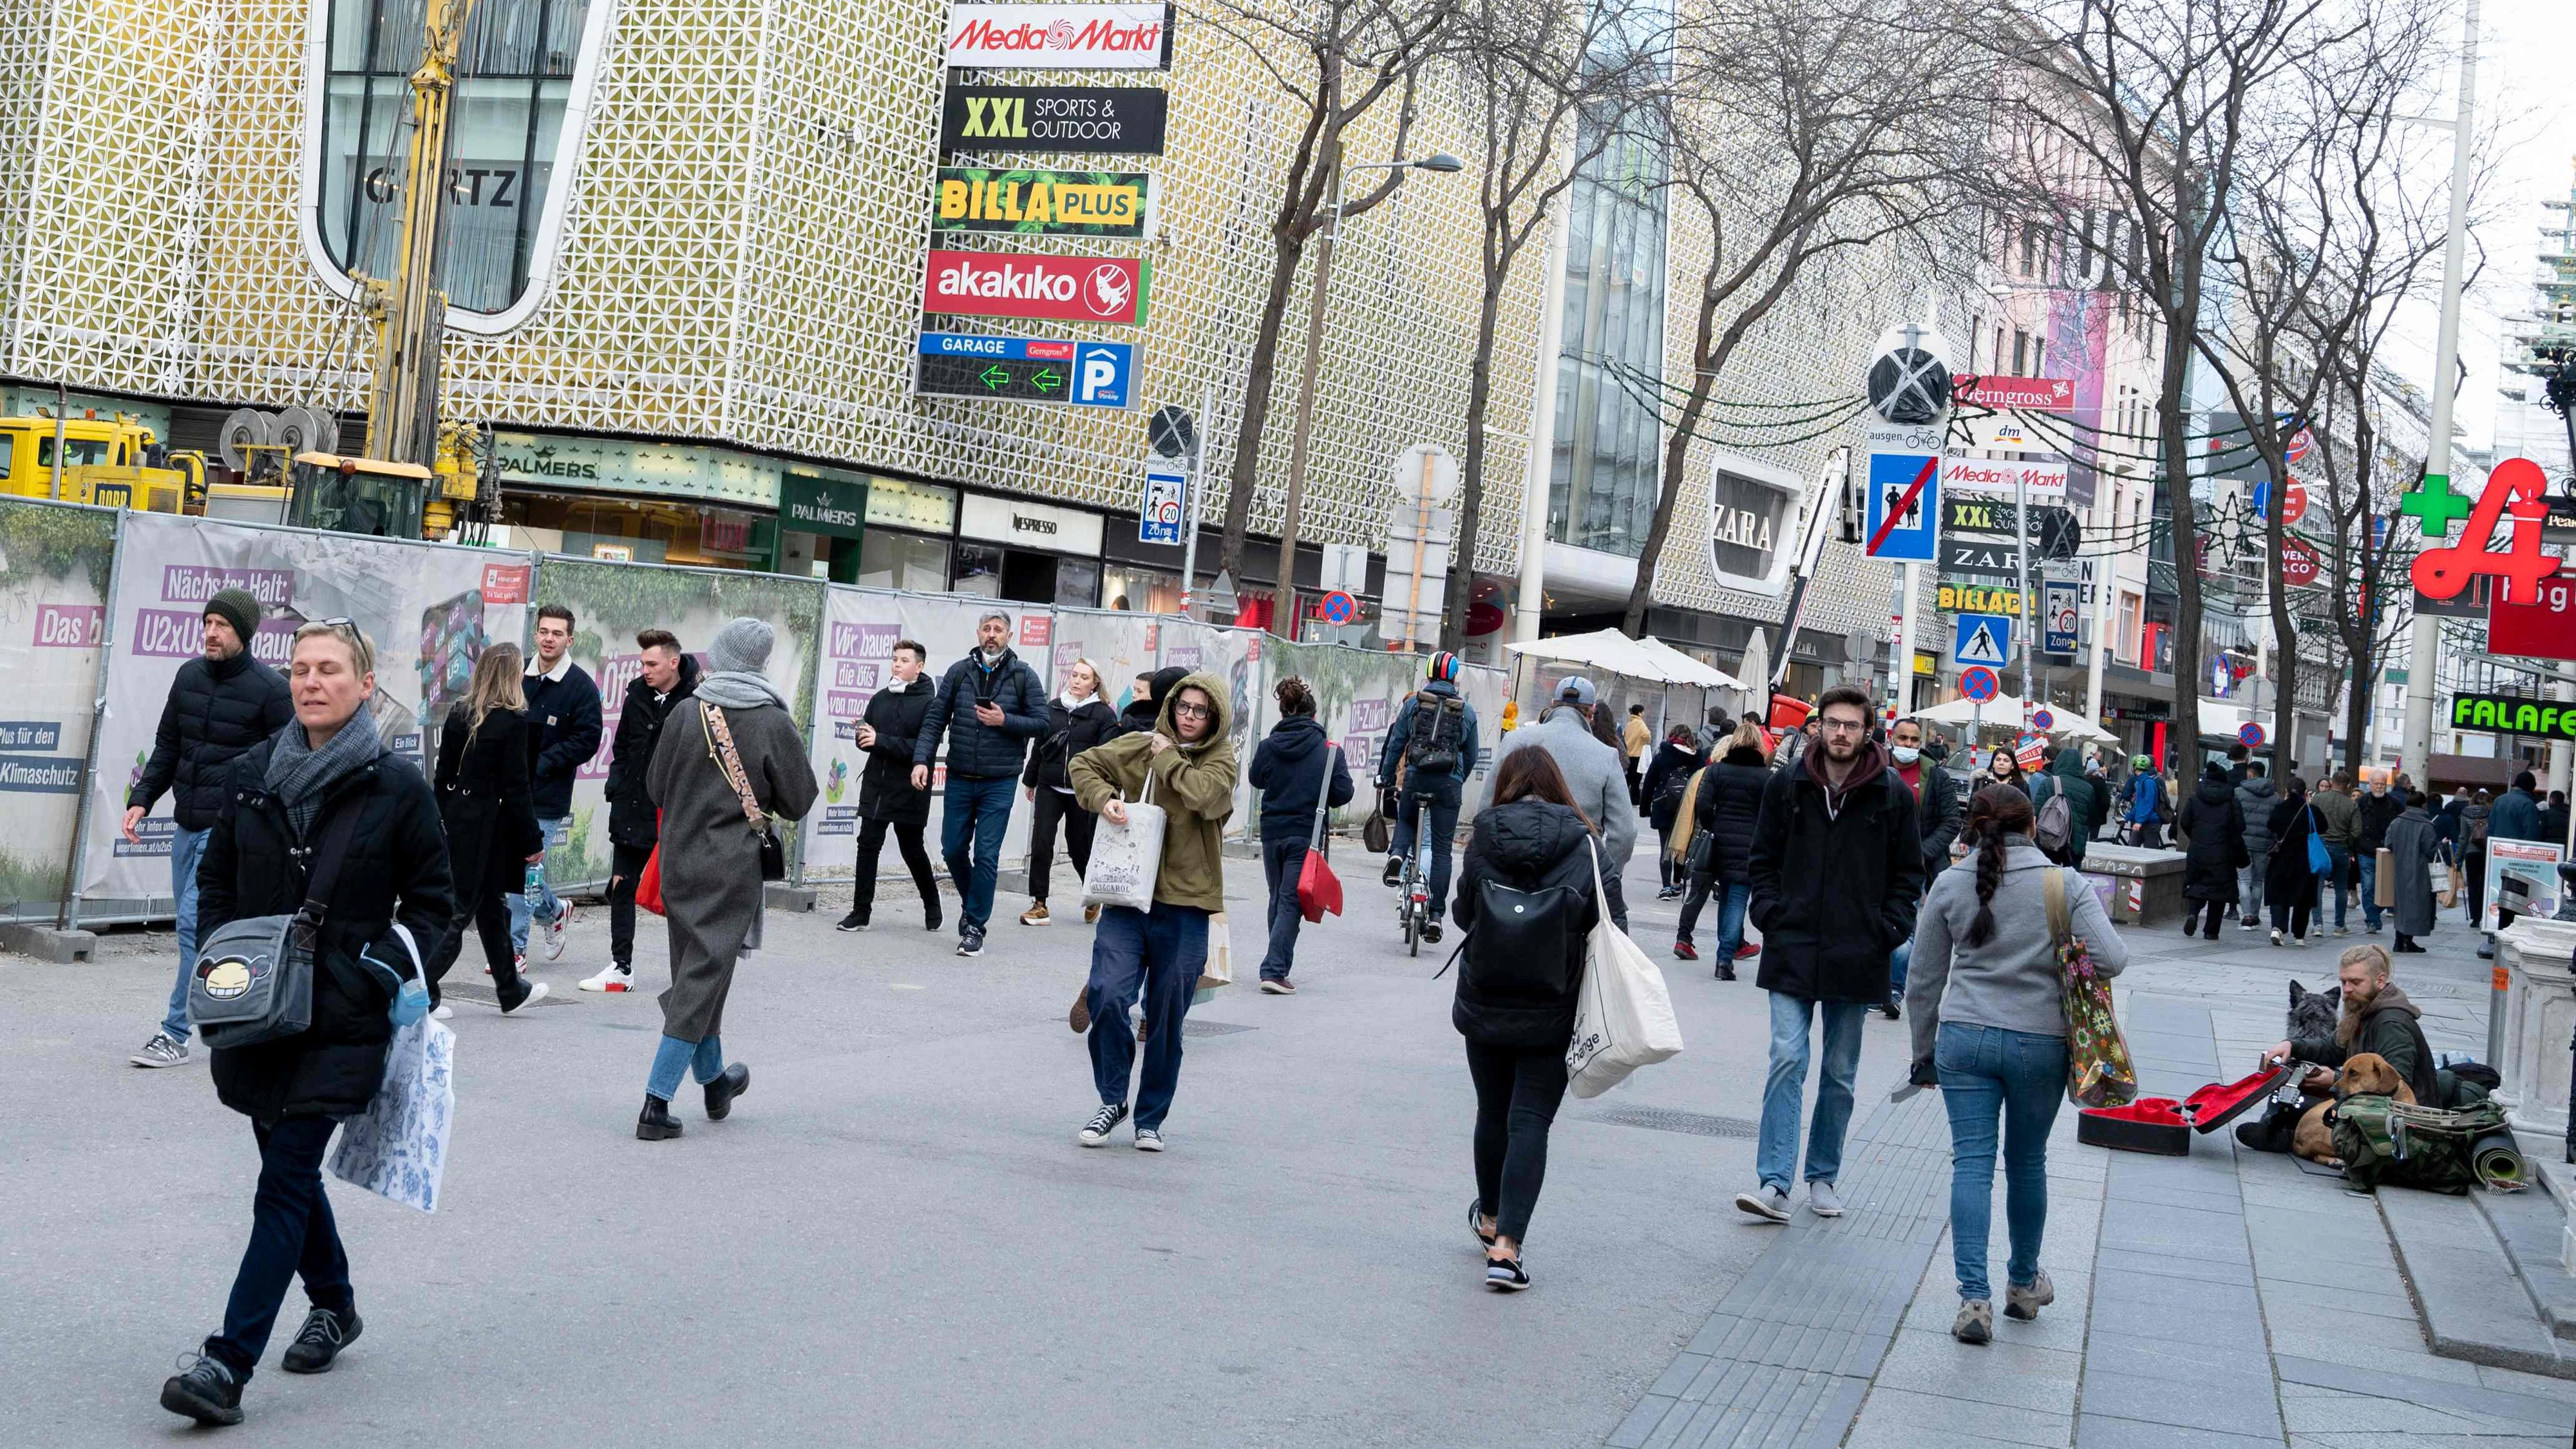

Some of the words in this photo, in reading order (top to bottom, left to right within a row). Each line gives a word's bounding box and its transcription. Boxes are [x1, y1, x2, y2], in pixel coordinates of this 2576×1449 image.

[950, 18, 1046, 50] Media
[1068, 19, 1160, 52] Markt
[961, 97, 1028, 138] XXL
[1034, 99, 1097, 118] SPORTS
[1101, 99, 1115, 118] &
[1032, 120, 1121, 140] OUTDOOR
[366, 166, 516, 207] GRTZ
[940, 180, 1051, 223] BILLA
[1063, 192, 1129, 216] PLUS
[938, 261, 1077, 301] akakiko
[942, 338, 1005, 354] GARAGE
[1029, 345, 1063, 357] Gerngross
[1958, 386, 2052, 408] Gerngross
[1869, 431, 1905, 442] ausgen.
[1999, 424, 2021, 437] dm
[1943, 464, 2002, 484] Media
[2021, 471, 2067, 488] Markt
[791, 504, 857, 527] PALMERS
[1012, 512, 1057, 536] NESPRESSO
[1164, 507, 1177, 521] 20
[1953, 504, 1993, 528] XXL
[1712, 502, 1773, 553] ZARA
[2290, 564, 2310, 574] CO
[1938, 587, 2003, 612] BILLA
[41, 609, 82, 644] Das
[2064, 617, 2074, 630] 20
[860, 628, 898, 658] bauen
[1795, 641, 1817, 656] ZARA
[2050, 634, 2072, 647] Zone
[838, 663, 854, 685] die
[430, 681, 440, 701] U2
[1966, 696, 1988, 705] ANFANG
[829, 696, 846, 714] von
[2125, 710, 2148, 719] Street
[17, 727, 32, 744] für
[35, 727, 54, 744] den
[1, 762, 78, 786] Klimaschutz
[135, 821, 146, 832] ehr
[147, 820, 162, 832] Infos
[163, 820, 178, 831] unter
[1567, 1033, 1600, 1068] change
